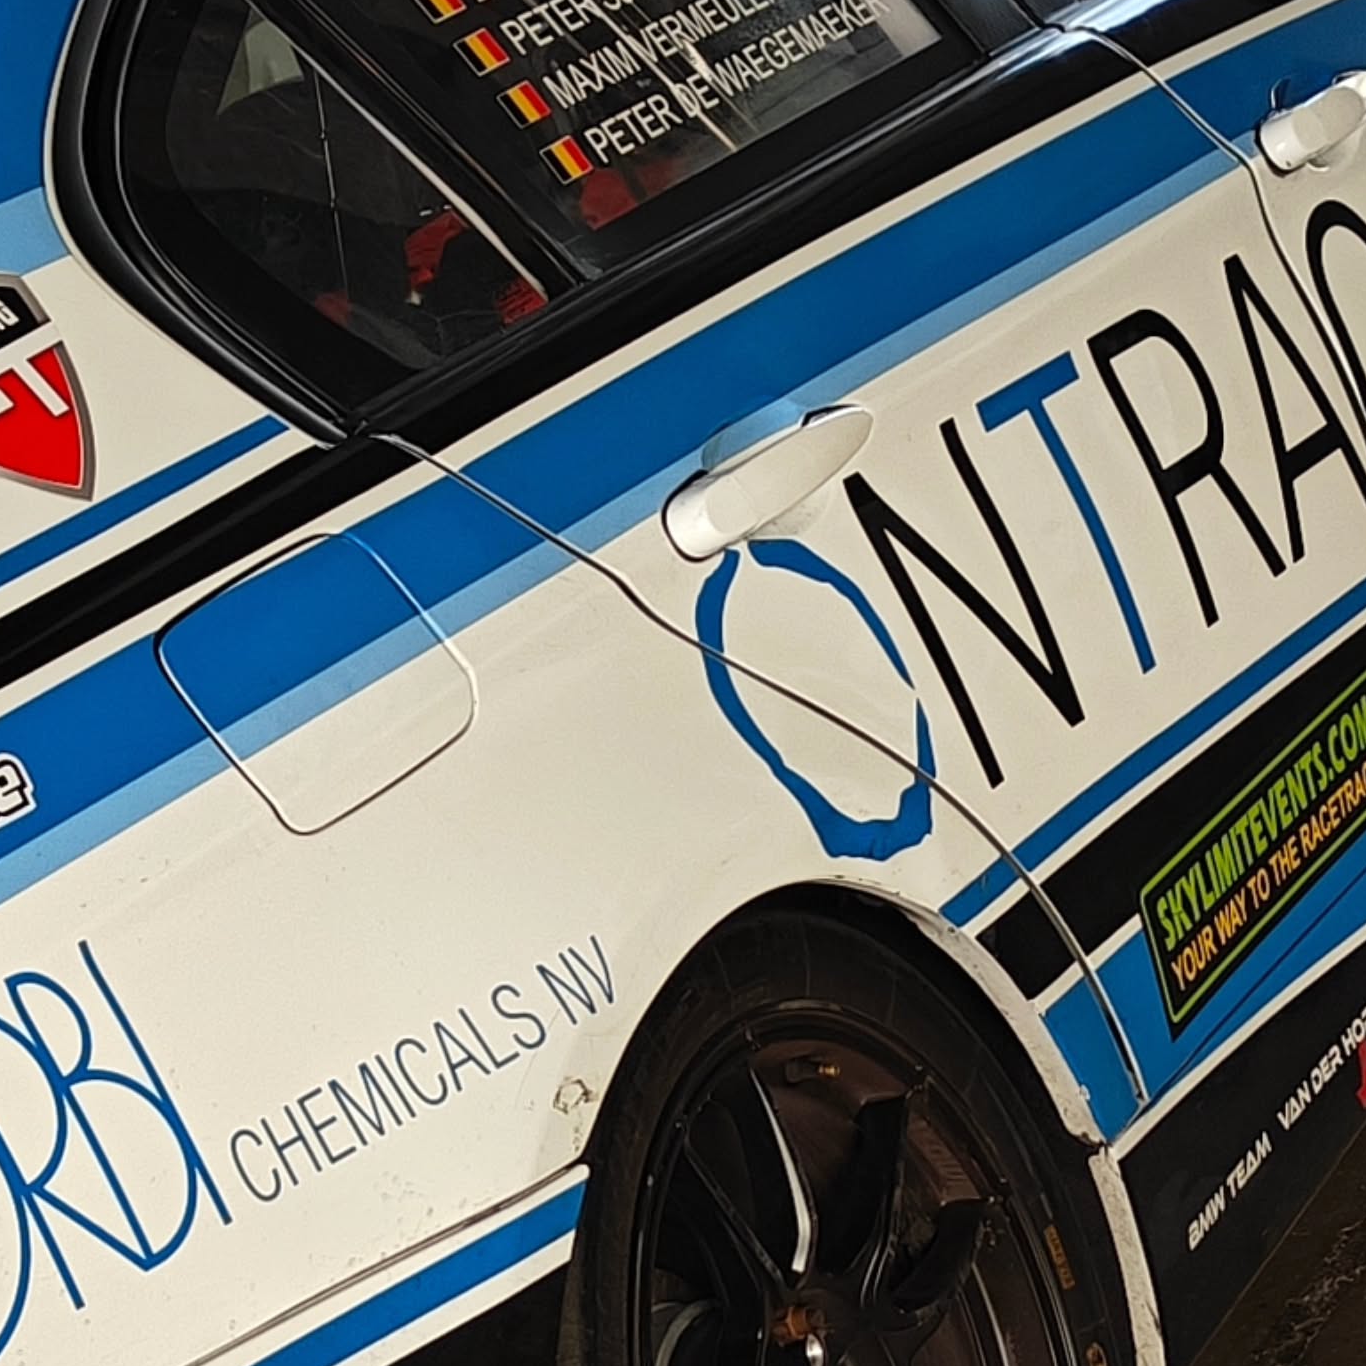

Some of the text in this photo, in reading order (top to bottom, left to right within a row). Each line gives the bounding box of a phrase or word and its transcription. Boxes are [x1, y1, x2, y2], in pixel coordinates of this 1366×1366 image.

[543, 35, 640, 110] MAXIM
[584, 94, 683, 163] PETER
[674, 75, 720, 119] DE
[1171, 926, 1218, 991] YOUR
[1214, 889, 1248, 947] WAY
[1247, 868, 1272, 911] TO
[1268, 843, 1302, 886] THE
[229, 983, 547, 1203] CHEMICALS
[536, 935, 618, 1026] NV
[1187, 1186, 1226, 1251] BMW
[1226, 1131, 1273, 1199] TEAM
[1276, 1080, 1311, 1130] VAN
[1311, 1044, 1345, 1095] DER
